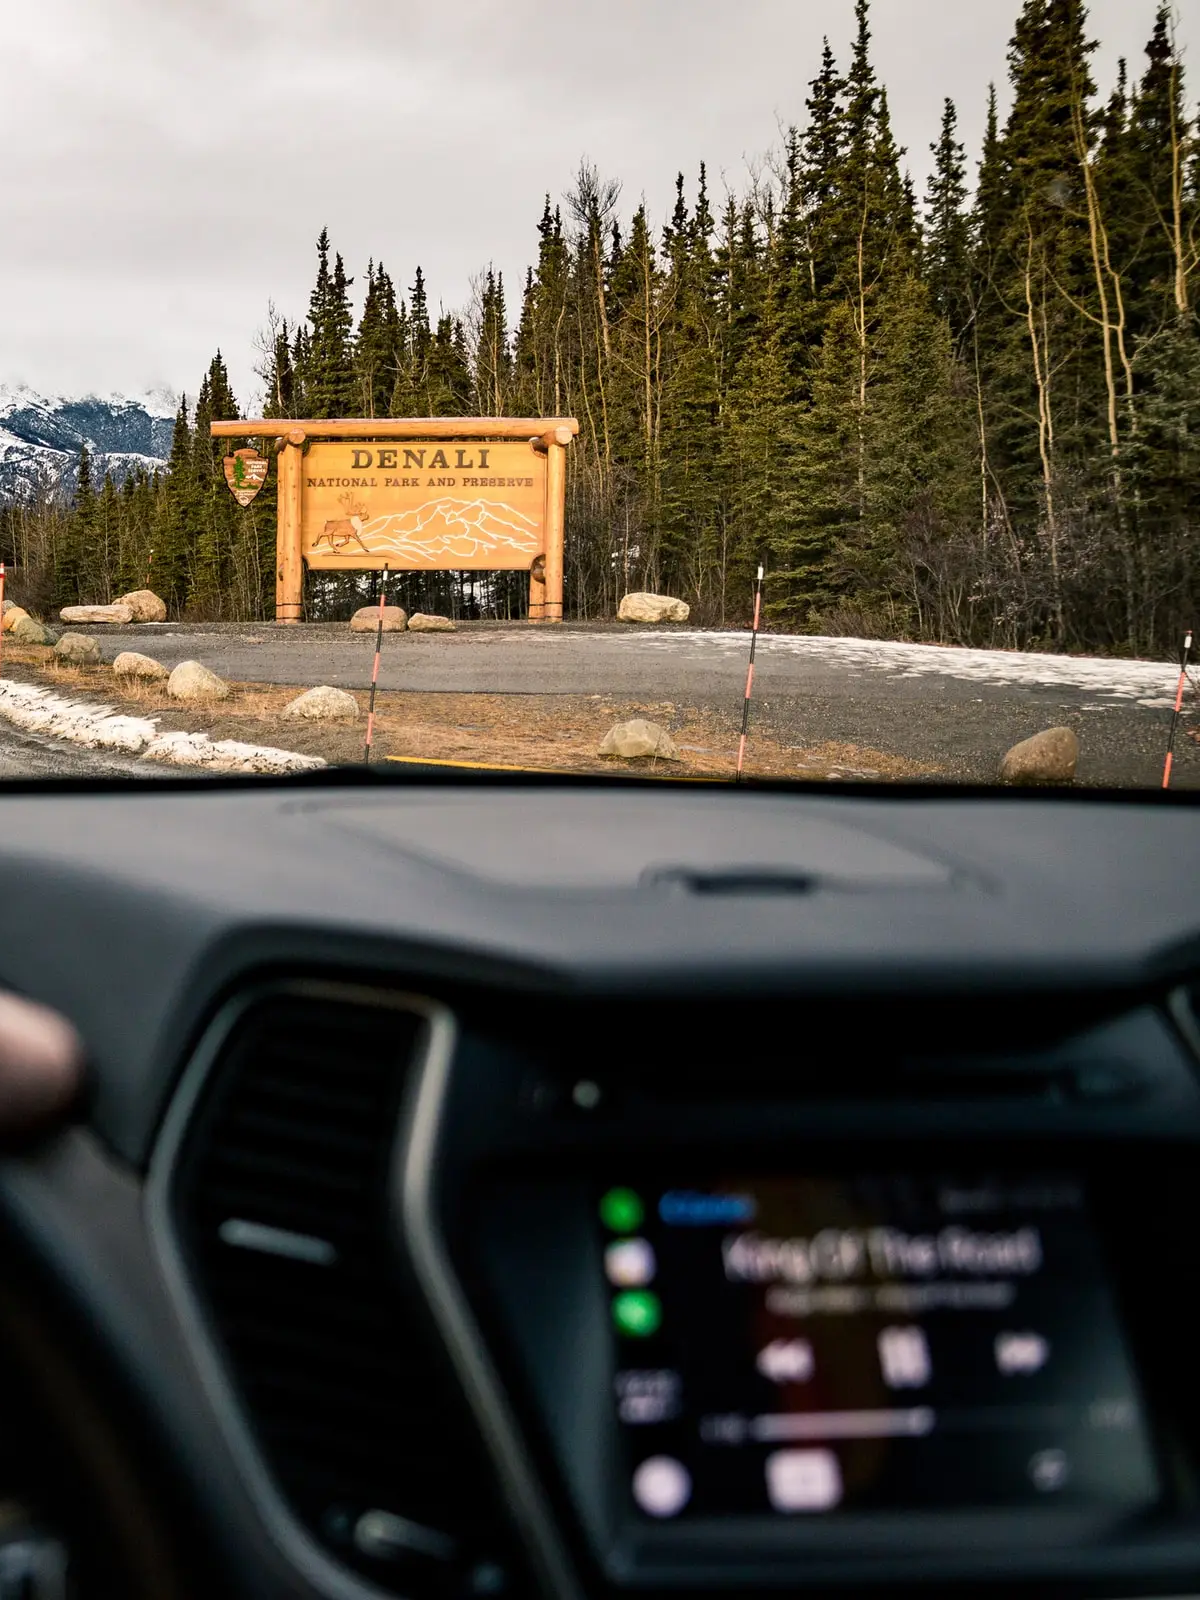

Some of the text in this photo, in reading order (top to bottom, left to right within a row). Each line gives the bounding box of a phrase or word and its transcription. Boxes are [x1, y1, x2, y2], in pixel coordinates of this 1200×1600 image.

[351, 449, 490, 469] DENALI
[307, 477, 534, 487] NATIONAL PARK AND PRESERVE
